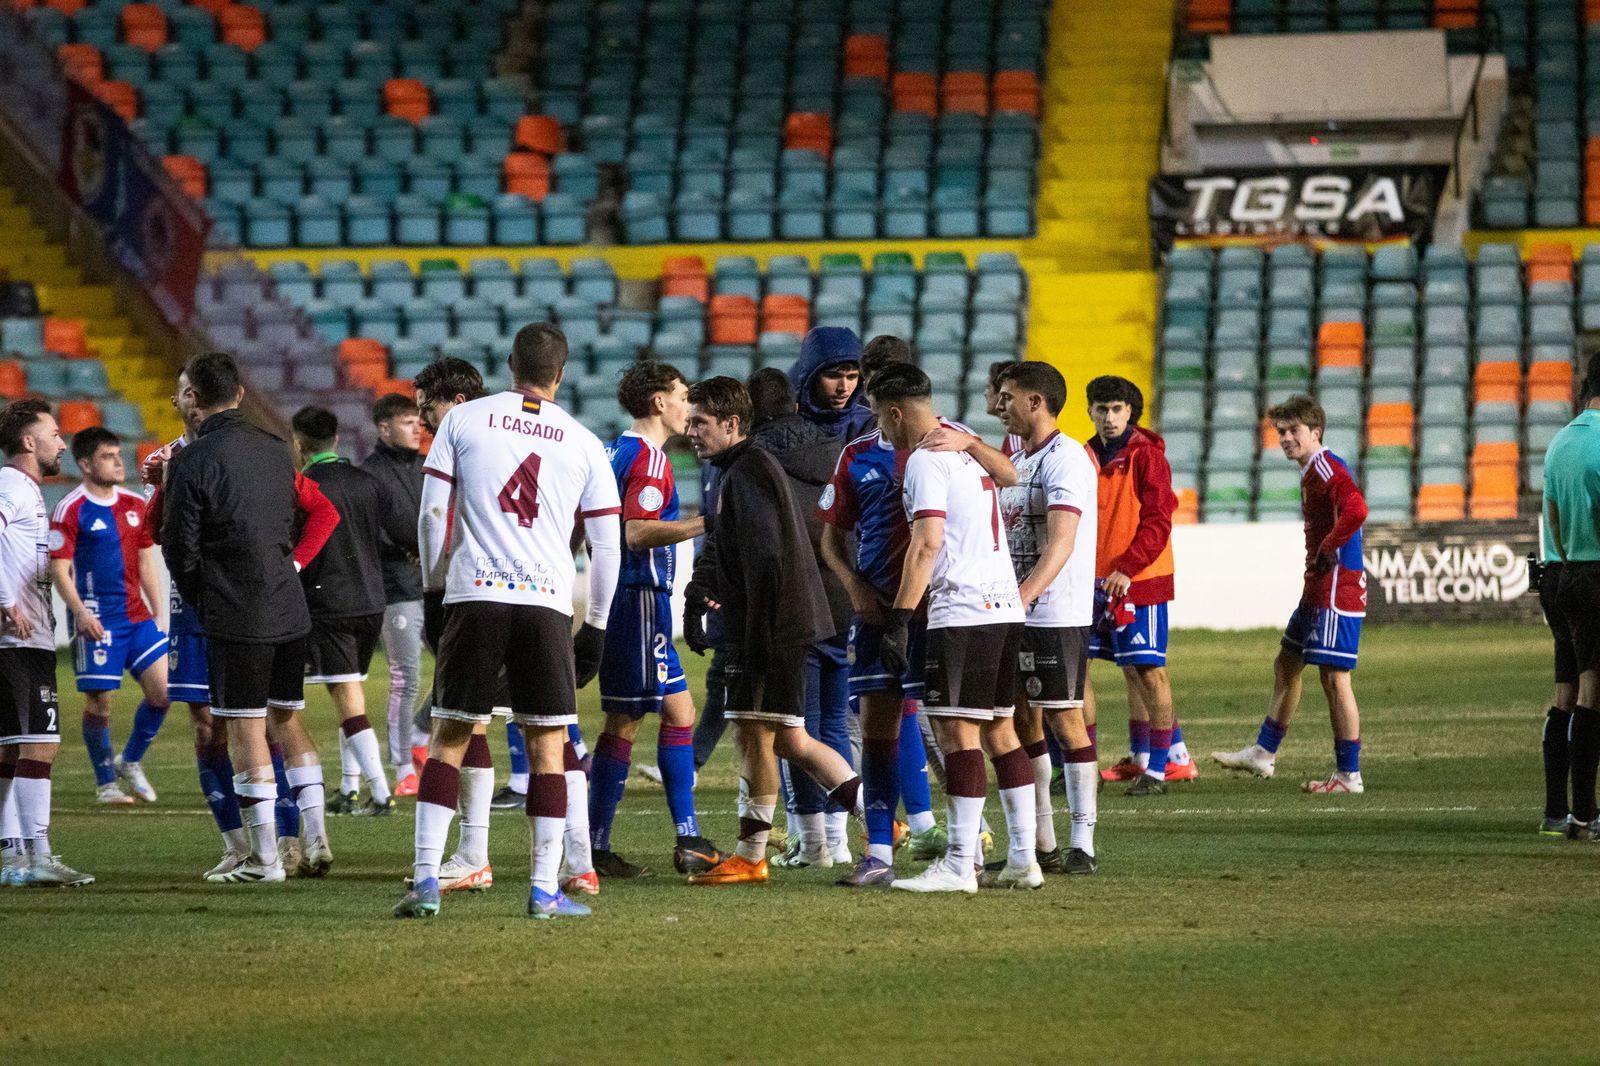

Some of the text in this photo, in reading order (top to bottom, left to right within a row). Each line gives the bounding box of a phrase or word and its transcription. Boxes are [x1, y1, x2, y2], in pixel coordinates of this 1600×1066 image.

[1184, 176, 1405, 222] TGSA
[488, 413, 564, 442] I. CASADO
[497, 451, 542, 529] 4
[1379, 575, 1500, 604] TELECOM
[46, 707, 57, 731] 2
